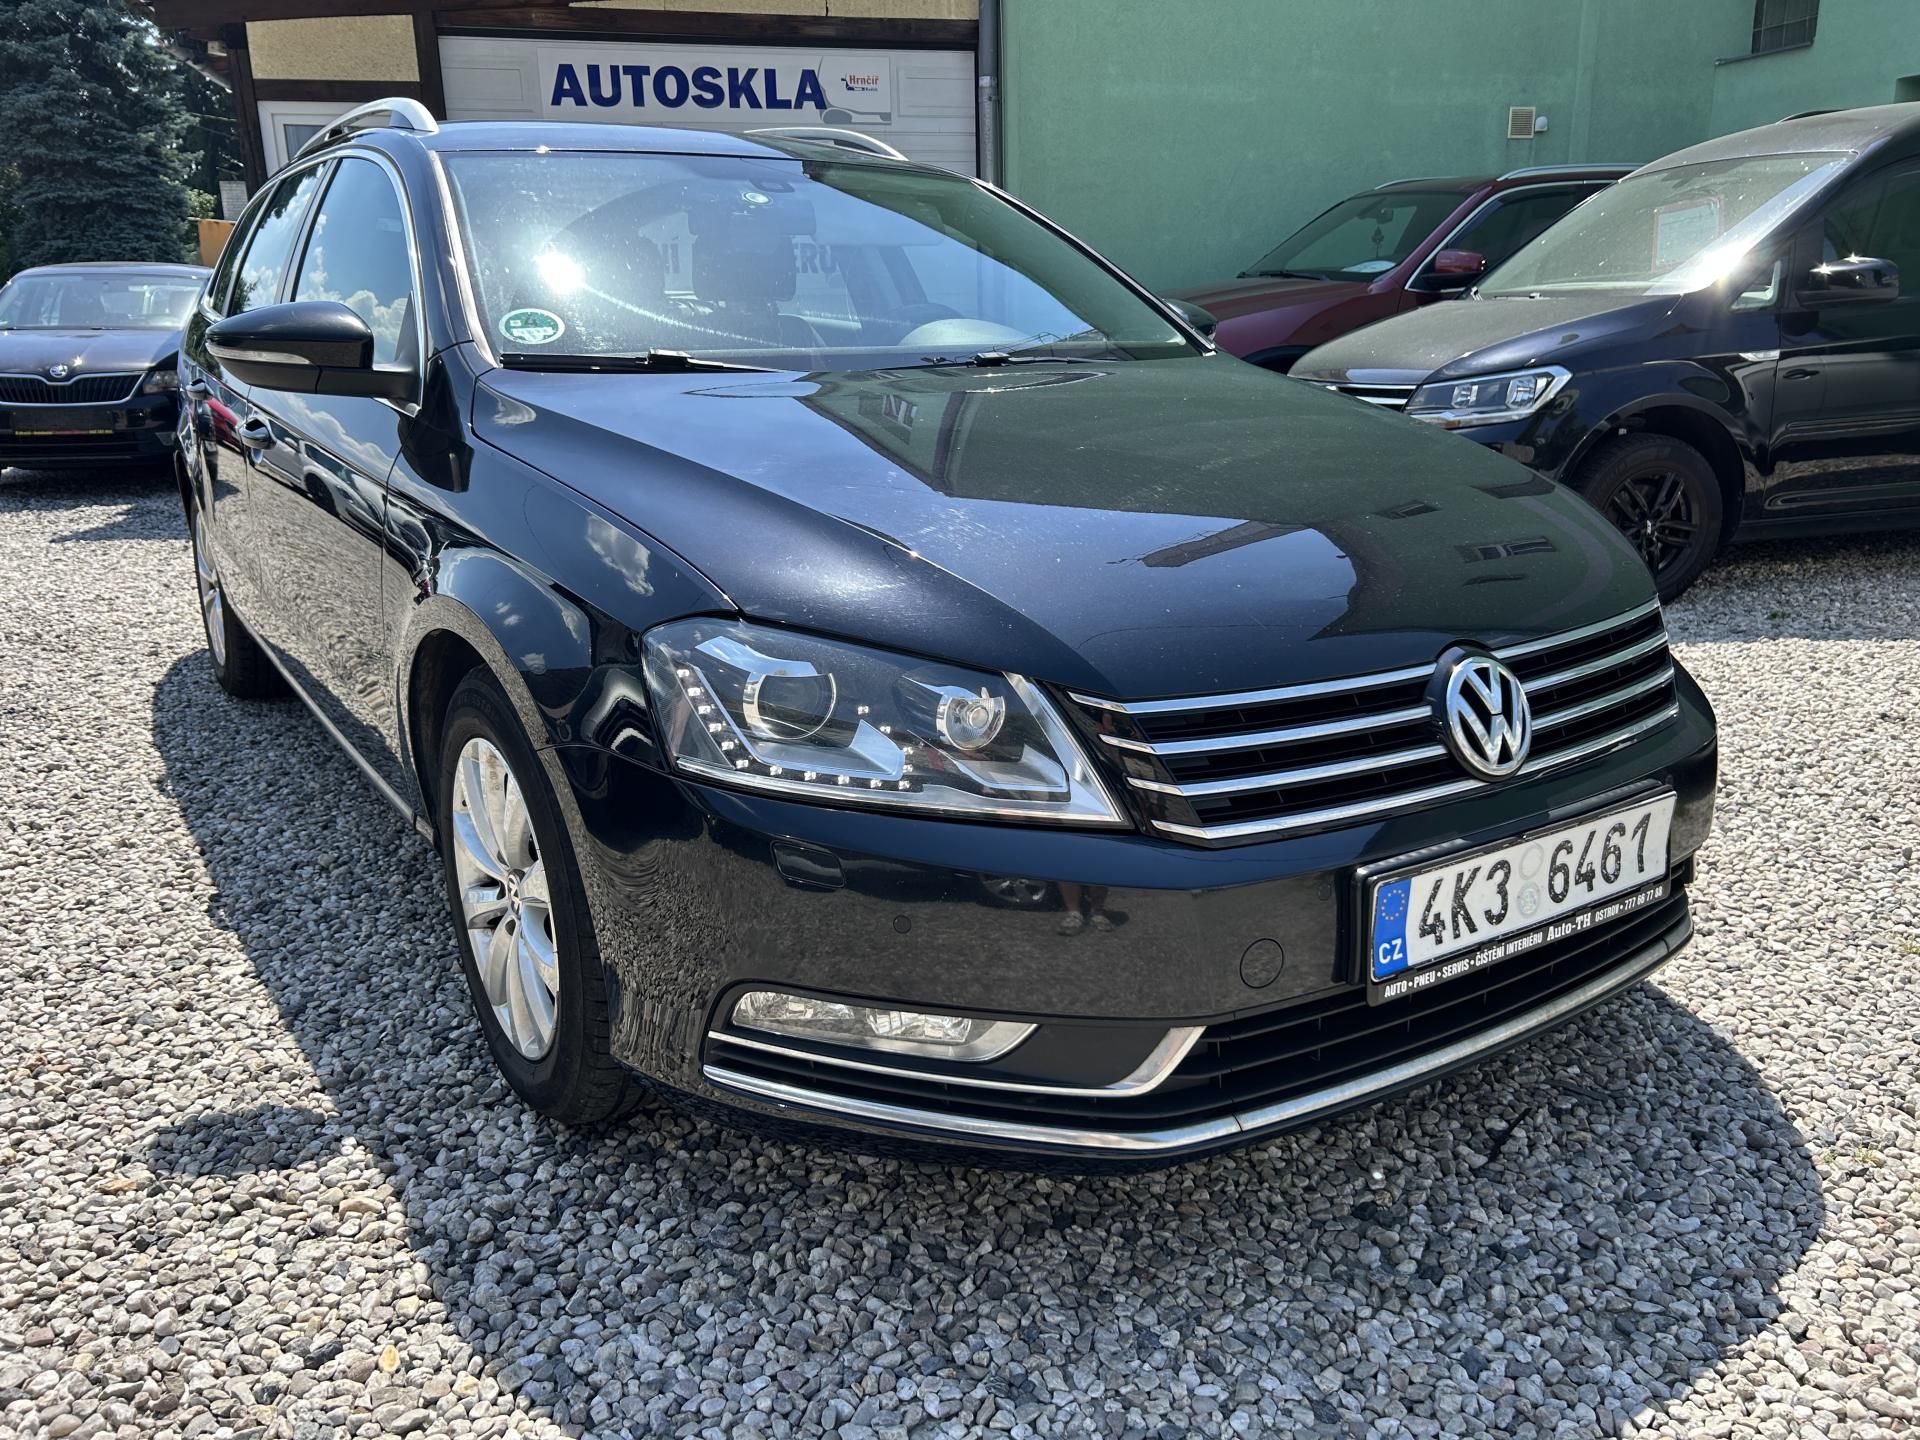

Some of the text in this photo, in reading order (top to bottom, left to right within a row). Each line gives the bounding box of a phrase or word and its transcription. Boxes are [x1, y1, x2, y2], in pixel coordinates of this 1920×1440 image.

[550, 63, 827, 110] AUTOSKLA
[1418, 812, 1652, 945] 4K3 6461
[1378, 938, 1403, 964] CZ
[1384, 980, 1407, 998] AUTO
[1413, 970, 1436, 989] PNEU
[1442, 958, 1470, 978] SERVIS
[1506, 931, 1543, 955] INTERIÉRU
[1546, 912, 1592, 941] Auto-TH
[1595, 903, 1620, 922] OSTROV
[1624, 896, 1636, 911] 777
[1646, 889, 1654, 902] 77
